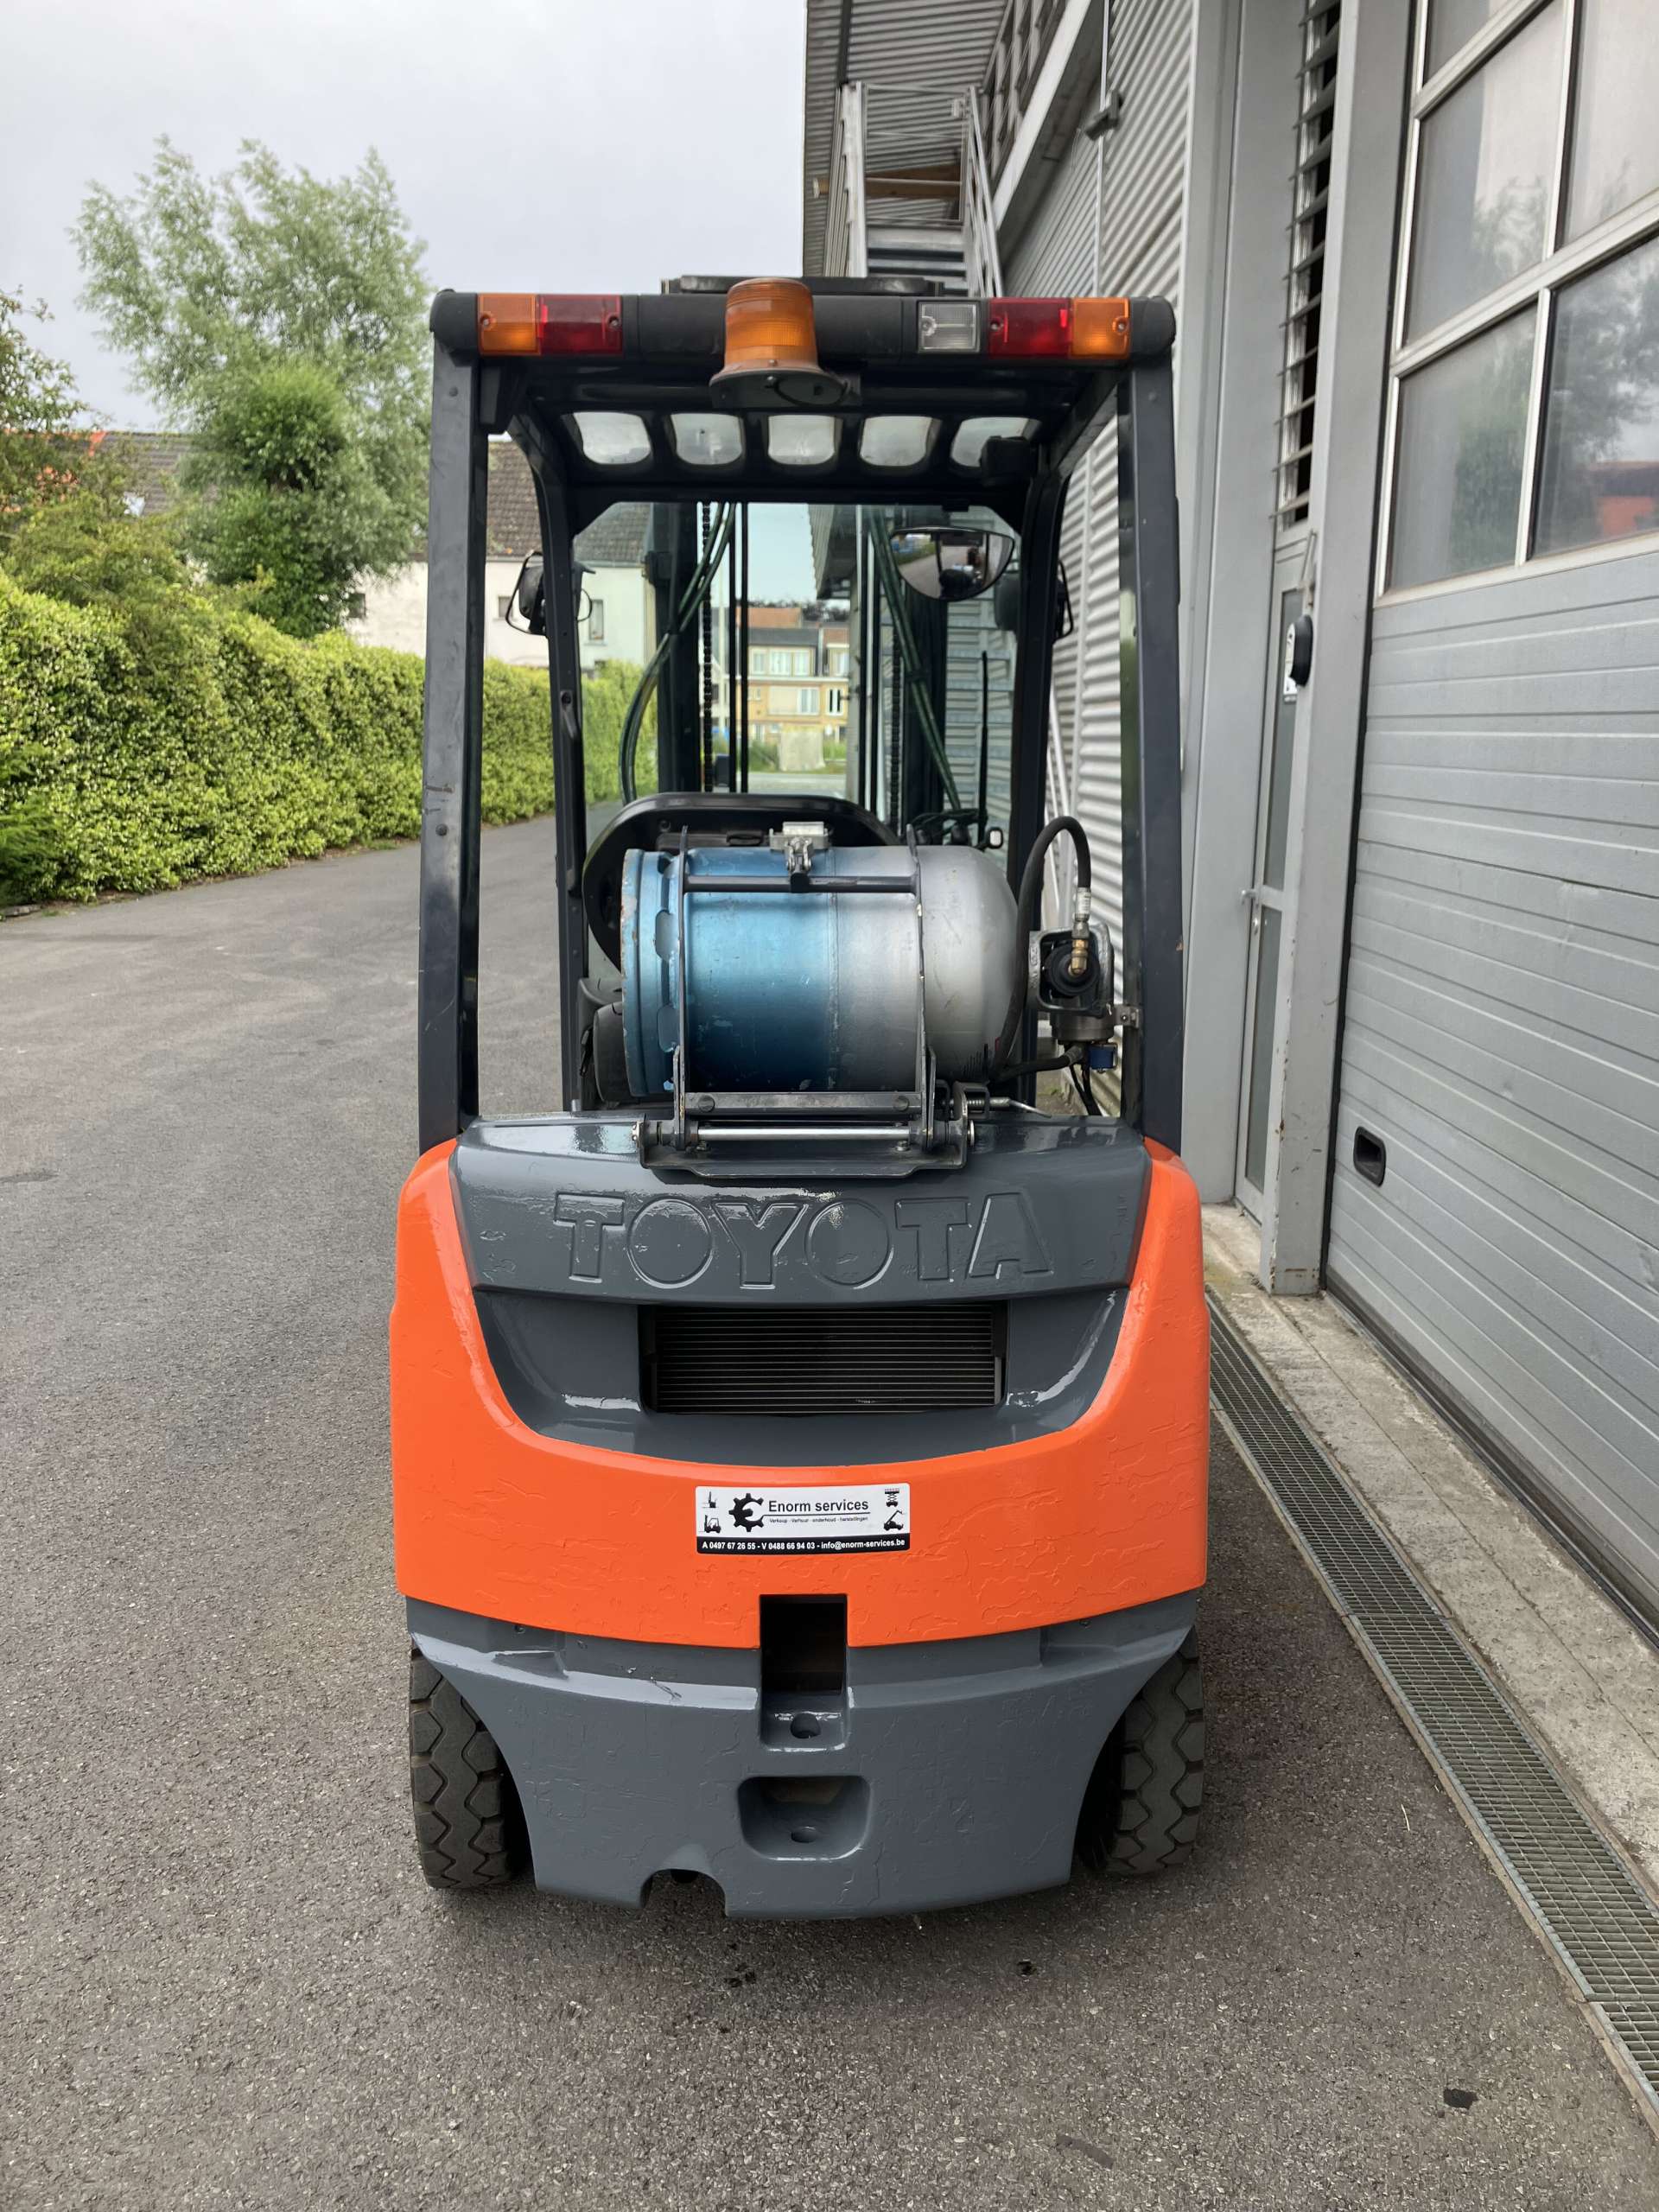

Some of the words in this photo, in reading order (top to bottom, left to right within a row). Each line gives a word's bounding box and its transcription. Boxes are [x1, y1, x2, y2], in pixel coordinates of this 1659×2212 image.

[553, 1191, 1054, 1290] TOYOTA
[768, 1500, 810, 1512] Enorm
[815, 1498, 869, 1511] services
[702, 1541, 709, 1549] A
[727, 1541, 735, 1550] 67
[737, 1541, 746, 1550] 26
[768, 1541, 785, 1550] 0488
[786, 1541, 795, 1550] 66
[796, 1541, 805, 1550] 94
[821, 1538, 906, 1550] info@enorm-services.be
